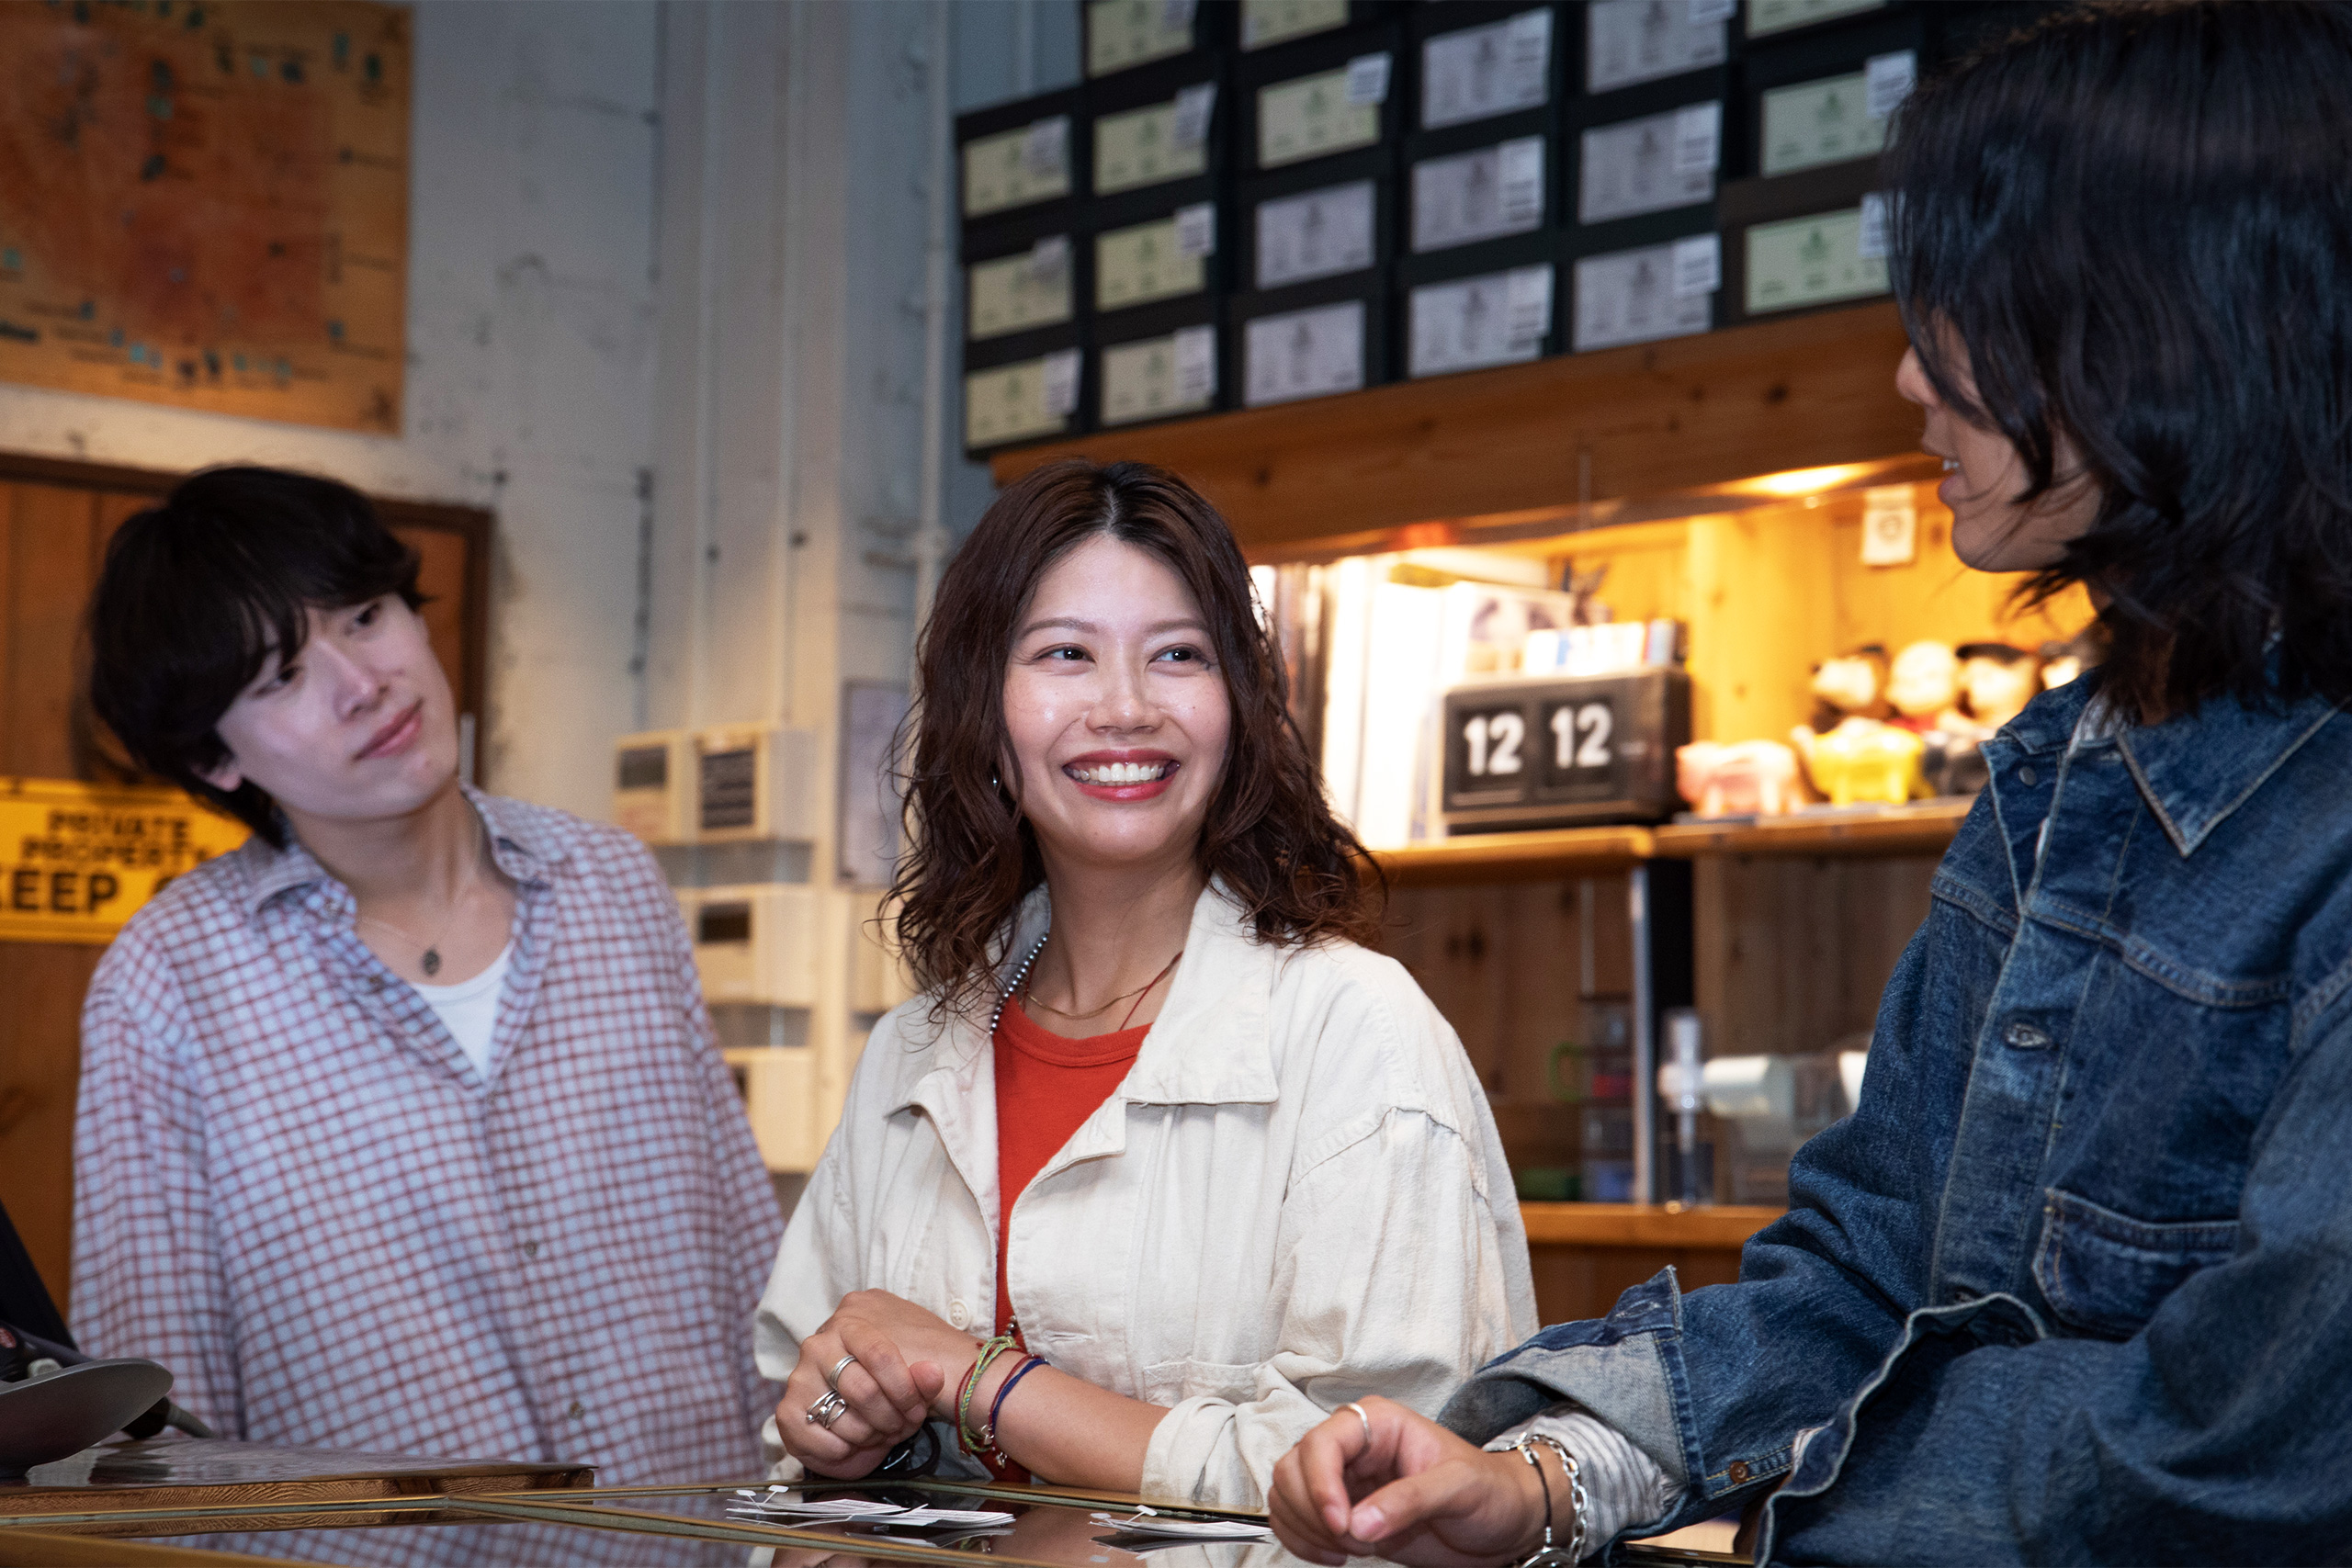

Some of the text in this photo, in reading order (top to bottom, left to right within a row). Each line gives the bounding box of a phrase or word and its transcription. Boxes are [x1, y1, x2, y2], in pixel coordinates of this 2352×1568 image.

[1464, 703, 1612, 776] 12 12
[49, 810, 189, 842] PRIVATE
[0, 867, 119, 915] EEP
